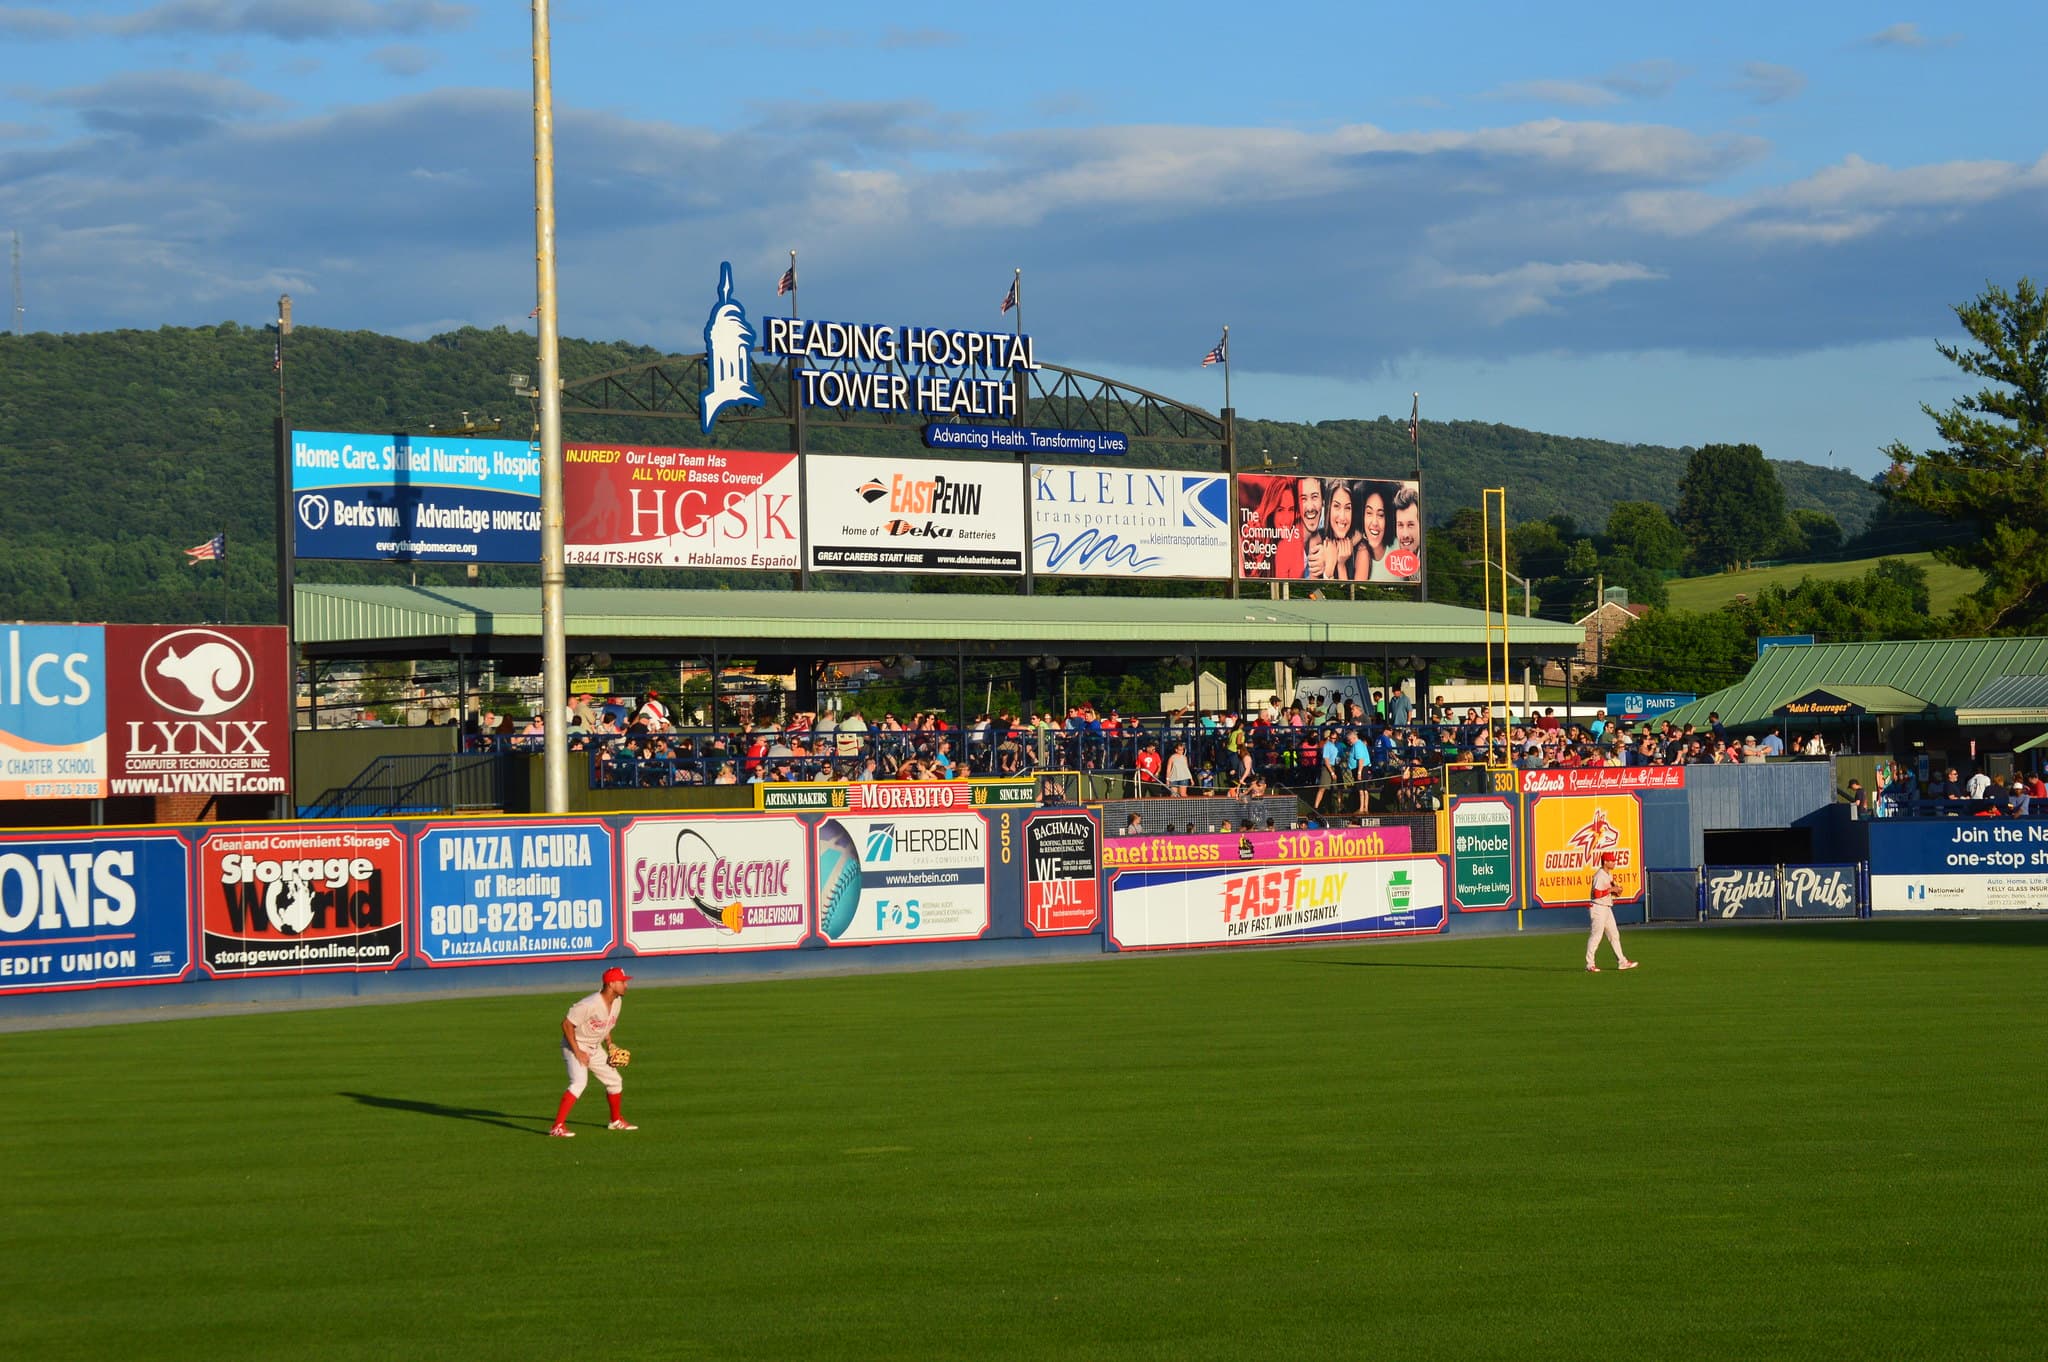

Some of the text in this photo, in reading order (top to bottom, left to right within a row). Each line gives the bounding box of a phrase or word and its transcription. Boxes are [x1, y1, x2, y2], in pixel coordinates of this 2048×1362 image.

[769, 318, 1042, 371] READING HOSPITAL
[800, 369, 1016, 416] TOWER HEALTH
[933, 428, 1126, 453] Advancing Health. Transforming Lives.
[295, 443, 541, 483] Home Care. Skilled Nursing. Hospic
[565, 450, 727, 468] INJURED? Our Legal Team Has
[631, 468, 764, 486] ALL YOUR Bases Covered
[1035, 469, 1167, 507] KLEIN
[333, 500, 375, 528] Berks
[376, 506, 401, 528] VNA
[415, 502, 490, 534] Advantage
[492, 510, 523, 531] HOME
[1036, 510, 1167, 528] transportation
[1240, 507, 1260, 522] The
[841, 519, 997, 540] Home of Deka Batteries
[1241, 524, 1300, 543] Community's
[375, 540, 478, 555] everythinghomecare.org
[817, 552, 924, 564] GREAT CAREERS START HERE
[1242, 539, 1278, 558] College
[566, 551, 798, 570] 1-844 ITS-HGSK Hablamos Español
[937, 555, 1017, 566] www.dekabatteries.com
[1646, 698, 1676, 709] PAINTS
[125, 721, 270, 755] LYNX
[7, 758, 53, 775] CHARTER
[57, 758, 97, 774] SCHOOL
[125, 758, 270, 770] COMPUTER TECHNOLOGIES INC.
[111, 773, 285, 794] www.LYNXNET.com
[1495, 773, 1513, 792] 330
[1523, 770, 1565, 792] Salino's
[1638, 769, 1648, 784] &
[765, 784, 1033, 810] ARTISAN BAKERS MORABITO SINCE 1932
[895, 828, 979, 853] HERBEIN
[1000, 812, 1011, 864] 350
[1033, 822, 1090, 841] BACHMAN'S
[1951, 825, 2048, 843] Join the Na
[212, 834, 391, 851] Clean and Convenient Storage
[439, 833, 592, 871] PIAZZA ACURA
[1151, 838, 1220, 863] fitness
[1278, 834, 1311, 859] $10
[1314, 839, 1325, 858] a
[1328, 831, 1385, 858] Month
[1467, 833, 1508, 852] Phoebe
[1035, 857, 1062, 881] WE
[1472, 863, 1494, 876] Berks
[1545, 852, 1584, 870] GOLDEN
[1946, 849, 2048, 869] one-stop sh
[221, 853, 375, 889] Storage
[632, 856, 791, 904] SERVICE ELECTRIC
[885, 872, 959, 885] www.herbein.com
[1539, 873, 1638, 887] ALVERNIA URSITY
[0, 850, 137, 934] ONS
[474, 873, 561, 899] of Reading
[1042, 877, 1082, 907] NAIL
[1217, 868, 1349, 923] FAST PLAY
[1391, 890, 1411, 898] LOTTERY
[1457, 882, 1510, 895] Worry-Free Living
[1791, 867, 1852, 910] Phils
[430, 899, 603, 936] 800-828-2060
[654, 905, 800, 927] Est. 1948 CABLEVISION
[1037, 904, 1053, 929] IT
[1228, 904, 1340, 937] PLAY FAST. WIN INSTANTLY.
[61, 950, 136, 972] UNION
[214, 943, 390, 966] storageworldonline.com
